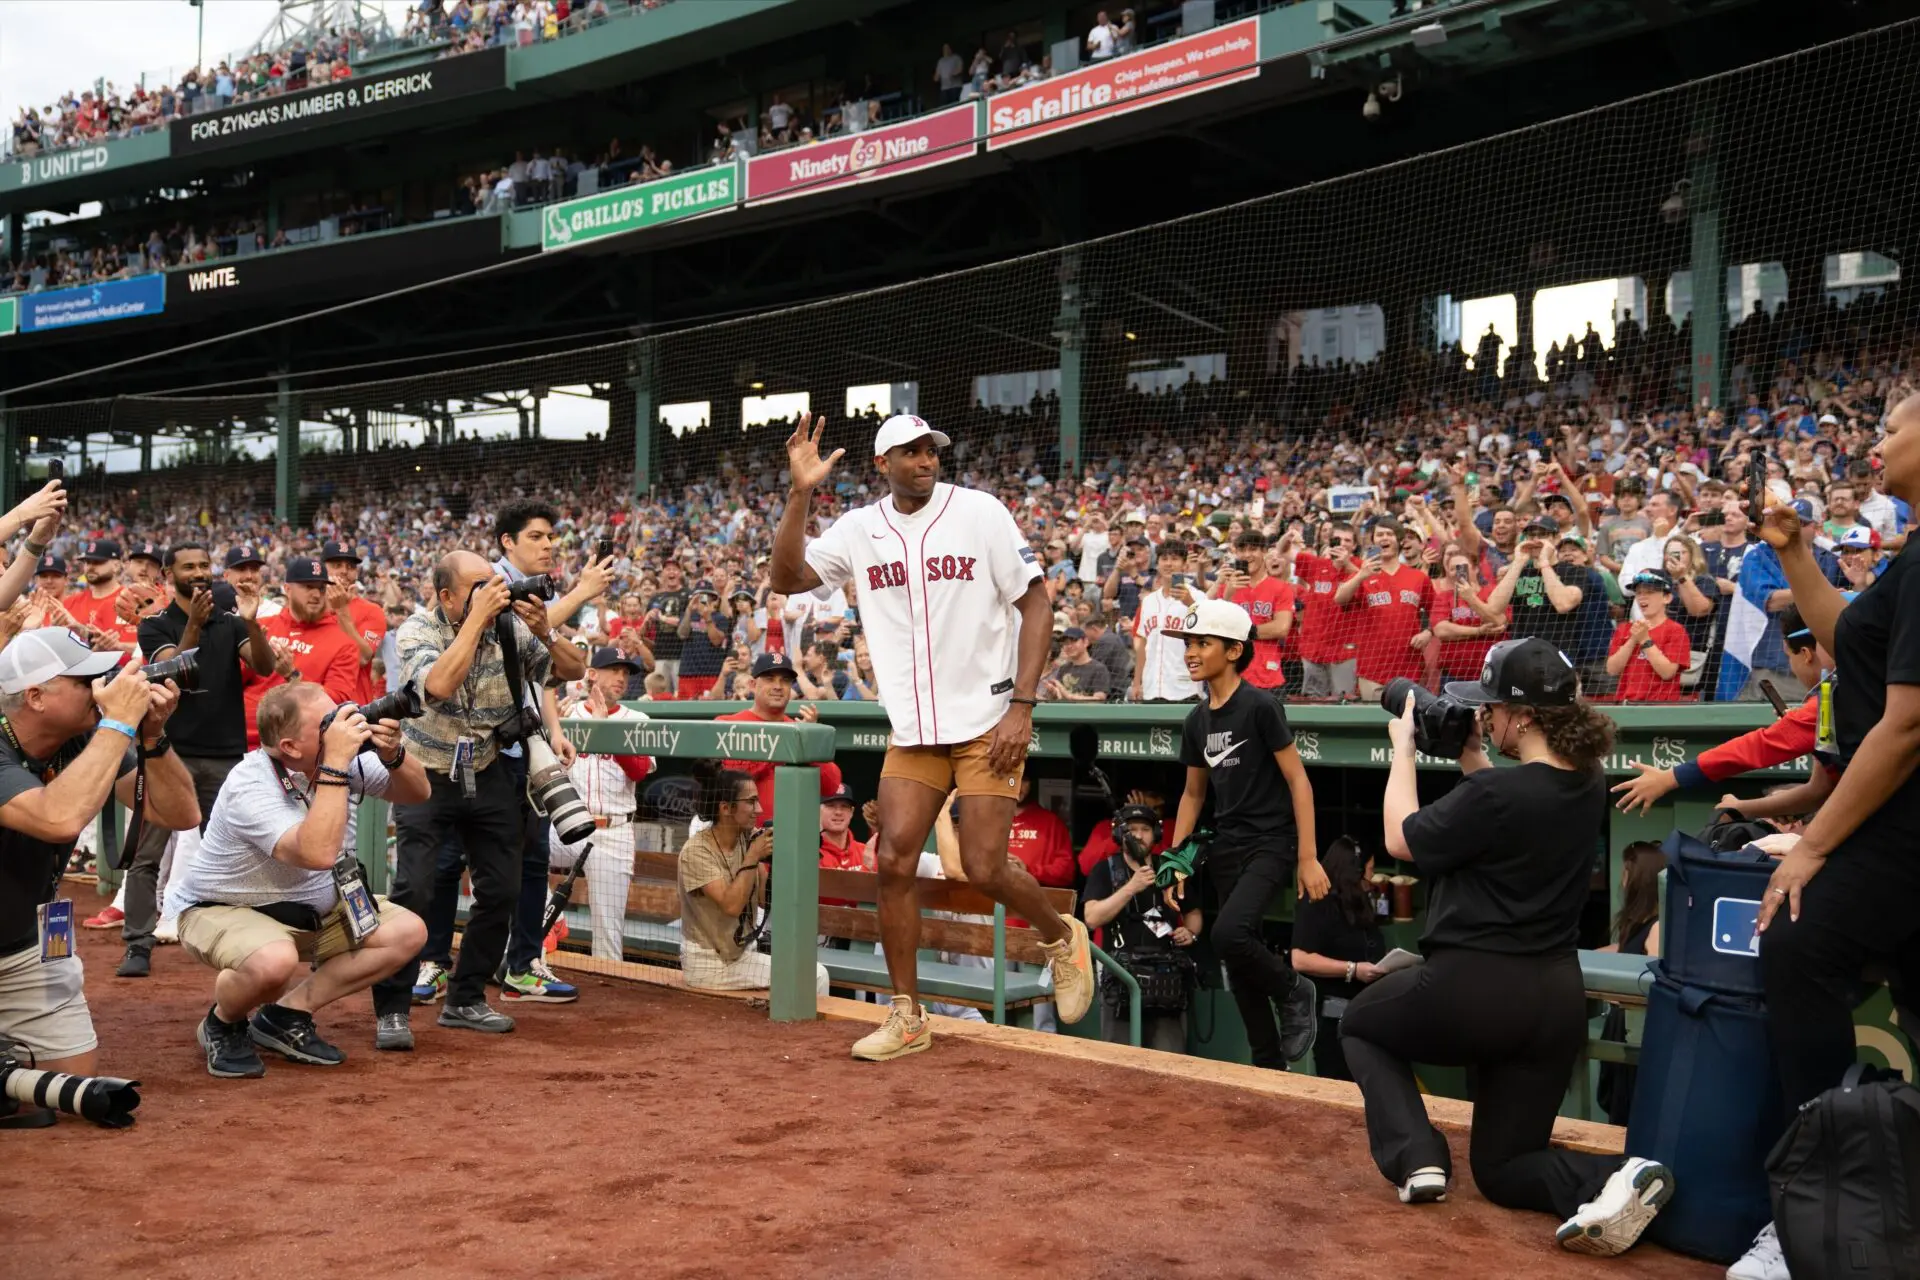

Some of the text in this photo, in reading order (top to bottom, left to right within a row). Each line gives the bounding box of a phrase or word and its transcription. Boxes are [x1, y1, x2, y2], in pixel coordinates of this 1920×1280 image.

[1186, 49, 1204, 64] We
[191, 117, 219, 141] FOR
[283, 91, 345, 121] NUMBER
[348, 88, 360, 108] 9,
[364, 72, 433, 103] DERRICK
[992, 82, 1112, 133] Safelite
[789, 154, 849, 181] Ninety
[884, 135, 929, 160] Nine
[571, 178, 730, 232] GRILLO'S PICKLES
[189, 267, 240, 292] WHITE.
[866, 555, 977, 591] RED SOX
[623, 722, 680, 755] xfinity
[716, 725, 780, 759] xfinity
[1207, 731, 1233, 753] NIKE
